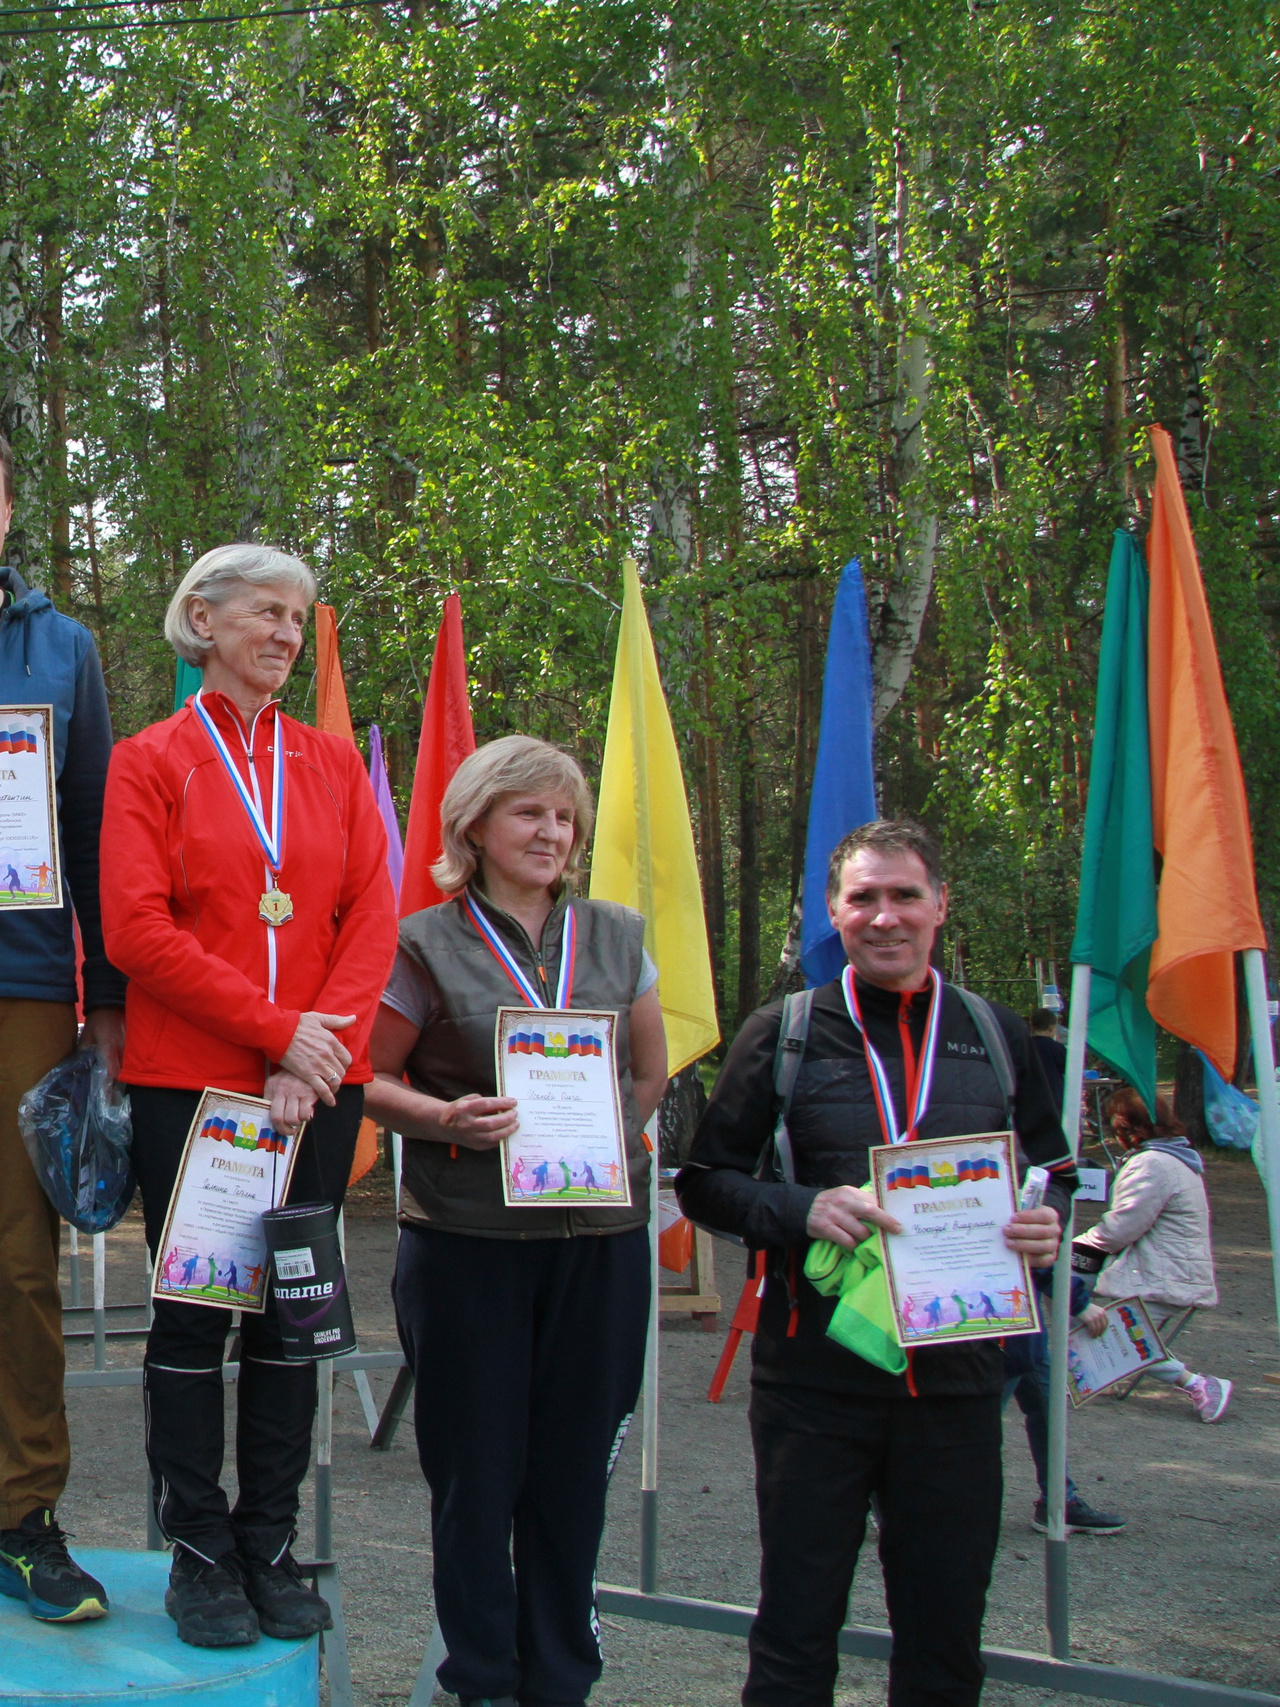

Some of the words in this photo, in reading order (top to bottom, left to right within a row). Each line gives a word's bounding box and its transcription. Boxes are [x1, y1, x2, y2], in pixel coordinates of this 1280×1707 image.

[273, 902, 278, 911] 1
[529, 1070, 586, 1081] ГРАМОТА
[211, 1157, 265, 1178] ГРАМОТА
[913, 1197, 981, 1214] ГРАМОТА
[273, 1282, 333, 1299] oname
